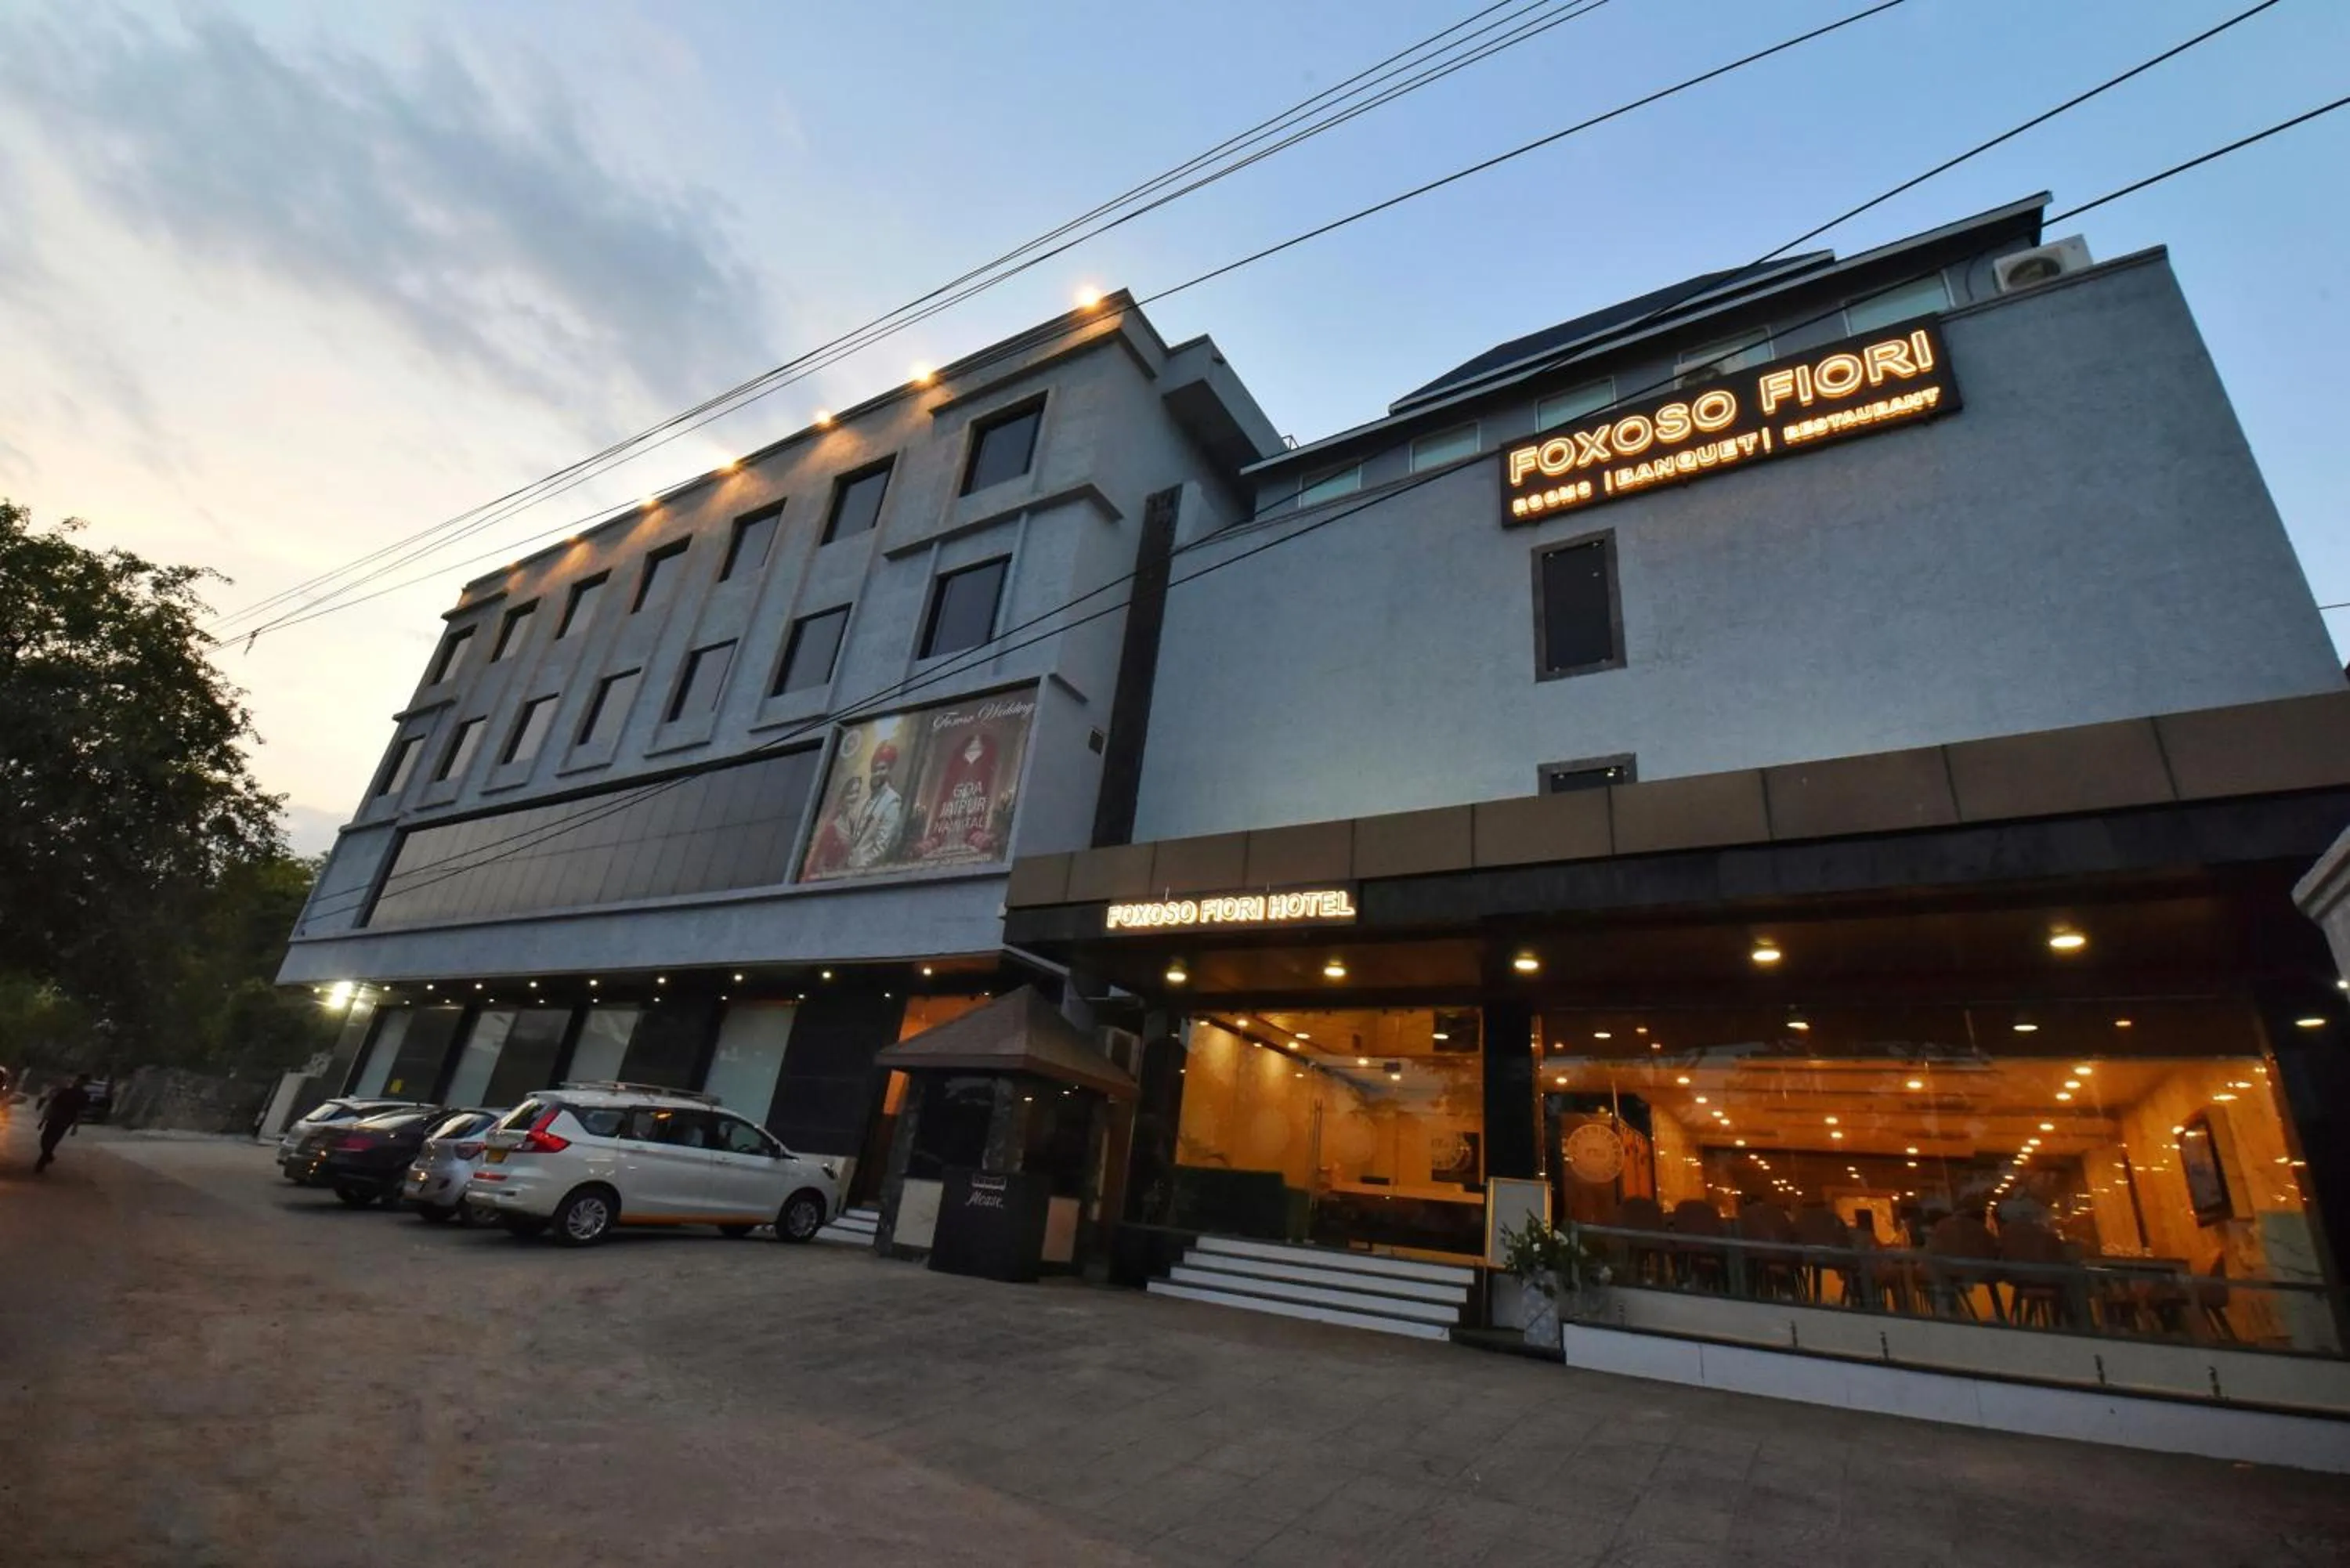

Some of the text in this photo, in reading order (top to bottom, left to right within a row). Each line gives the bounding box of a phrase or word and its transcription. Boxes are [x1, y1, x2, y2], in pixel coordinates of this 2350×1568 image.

[1509, 330, 1935, 486] FOXOSO FIORI
[1784, 386, 1940, 444] RESTAURANT
[940, 797, 986, 815] JAIPUR
[953, 780, 982, 797] GOA
[1107, 891, 1356, 929] FOXOSO FIORI HOTEL
